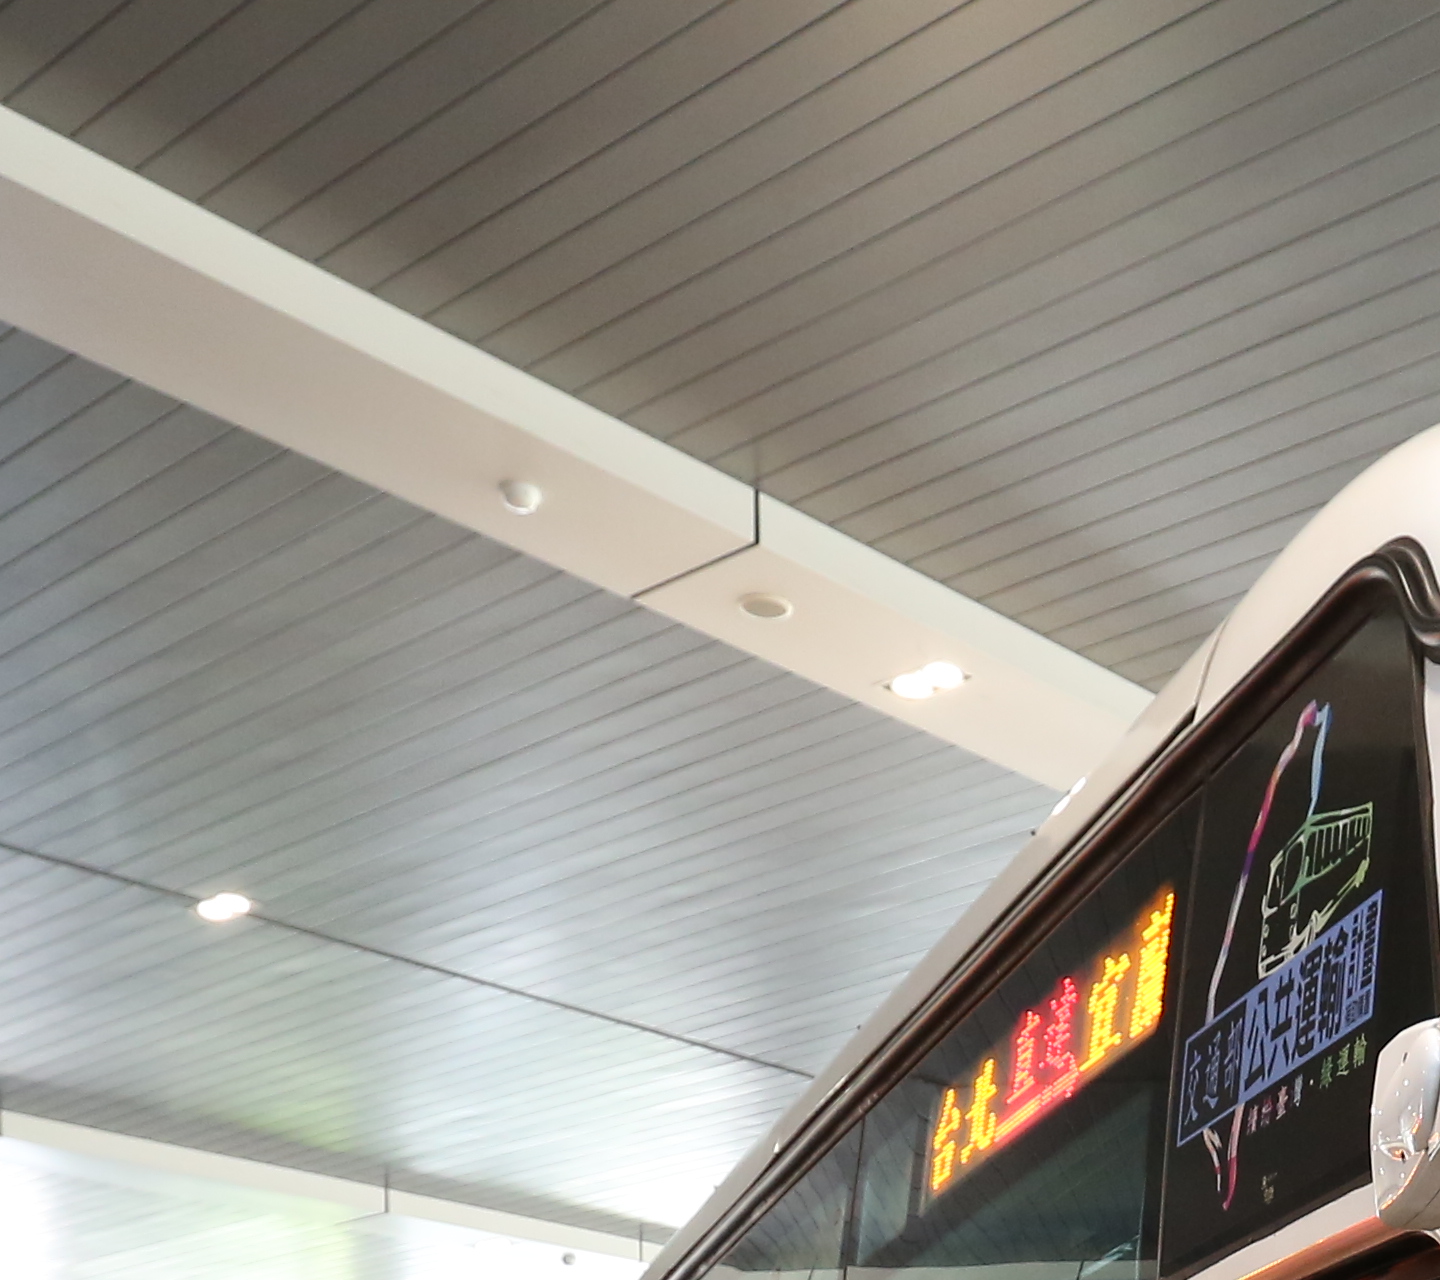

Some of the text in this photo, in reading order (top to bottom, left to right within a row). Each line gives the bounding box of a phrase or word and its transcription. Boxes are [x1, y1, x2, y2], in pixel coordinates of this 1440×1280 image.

[933, 1057, 998, 1191] 台北
[1007, 975, 1080, 1104] 直達
[1184, 1016, 1245, 1126] 交通部
